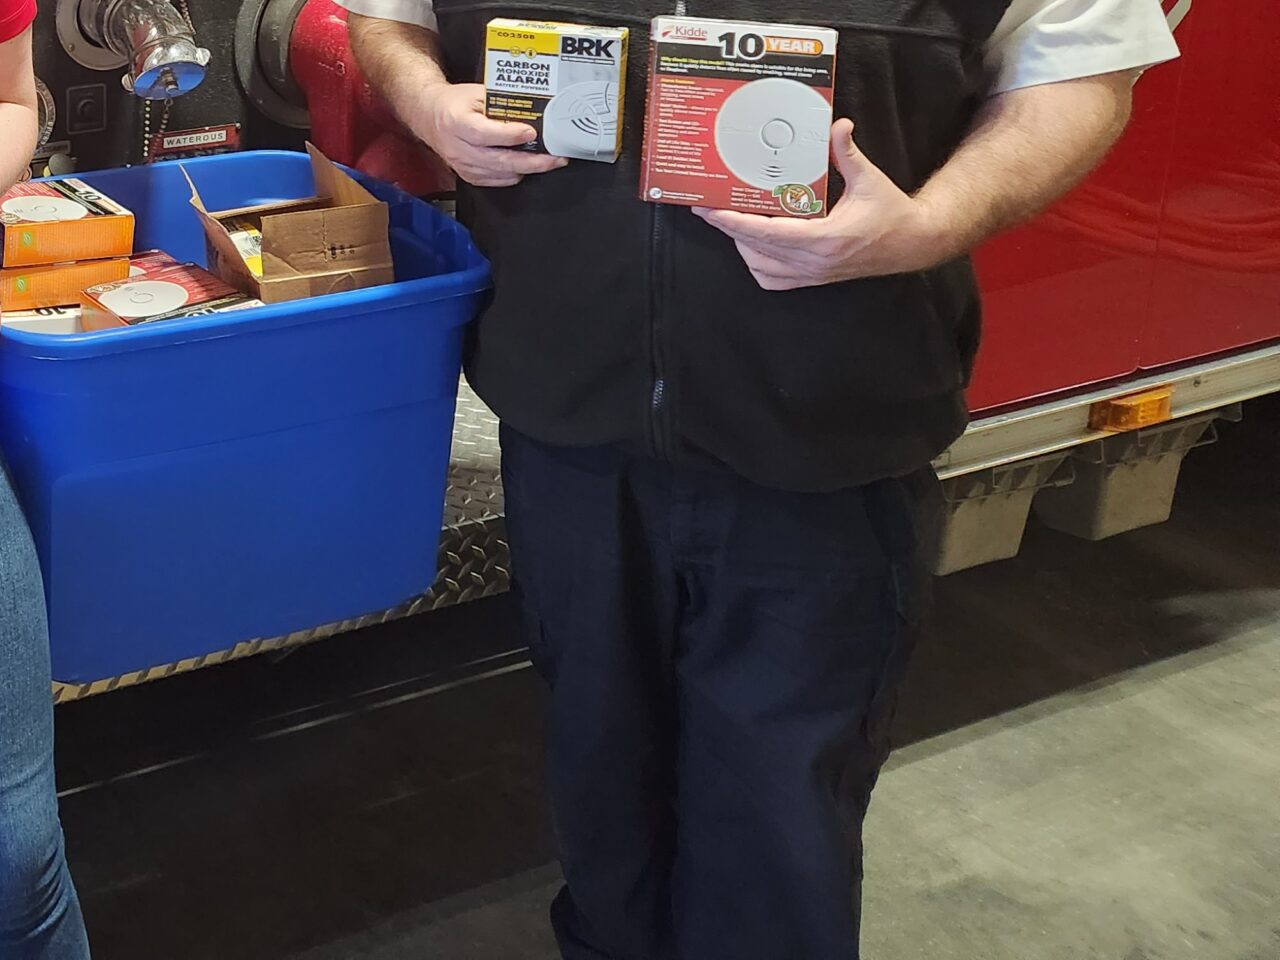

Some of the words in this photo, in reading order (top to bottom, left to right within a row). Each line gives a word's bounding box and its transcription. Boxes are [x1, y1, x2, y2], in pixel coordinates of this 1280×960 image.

[497, 31, 535, 40] CO250B
[676, 26, 708, 37] Kidde
[561, 36, 615, 58] BRK
[718, 31, 766, 60] 10
[769, 39, 815, 52] YEAR
[496, 60, 550, 71] CARBON
[496, 68, 550, 78] MONOXIDE
[495, 74, 550, 86] ALARM
[166, 133, 225, 146] WATEROUS
